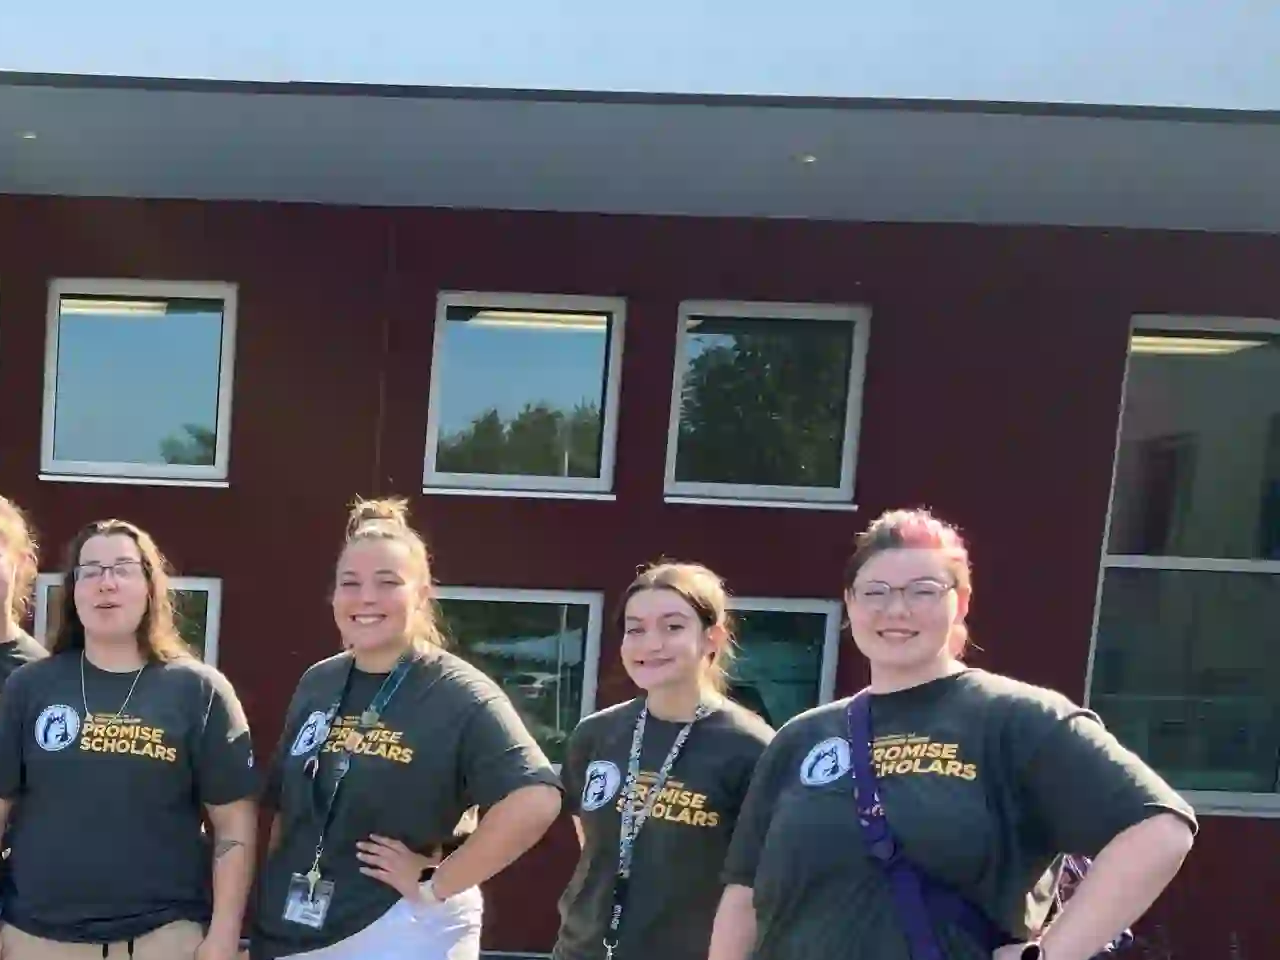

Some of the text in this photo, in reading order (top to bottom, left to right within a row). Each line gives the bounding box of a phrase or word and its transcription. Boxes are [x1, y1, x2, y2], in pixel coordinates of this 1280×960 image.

[82, 722, 165, 744] PROMISE
[79, 736, 177, 763] SCHOLARS
[873, 743, 959, 763] ROMISE
[876, 759, 977, 781] HOLARS
